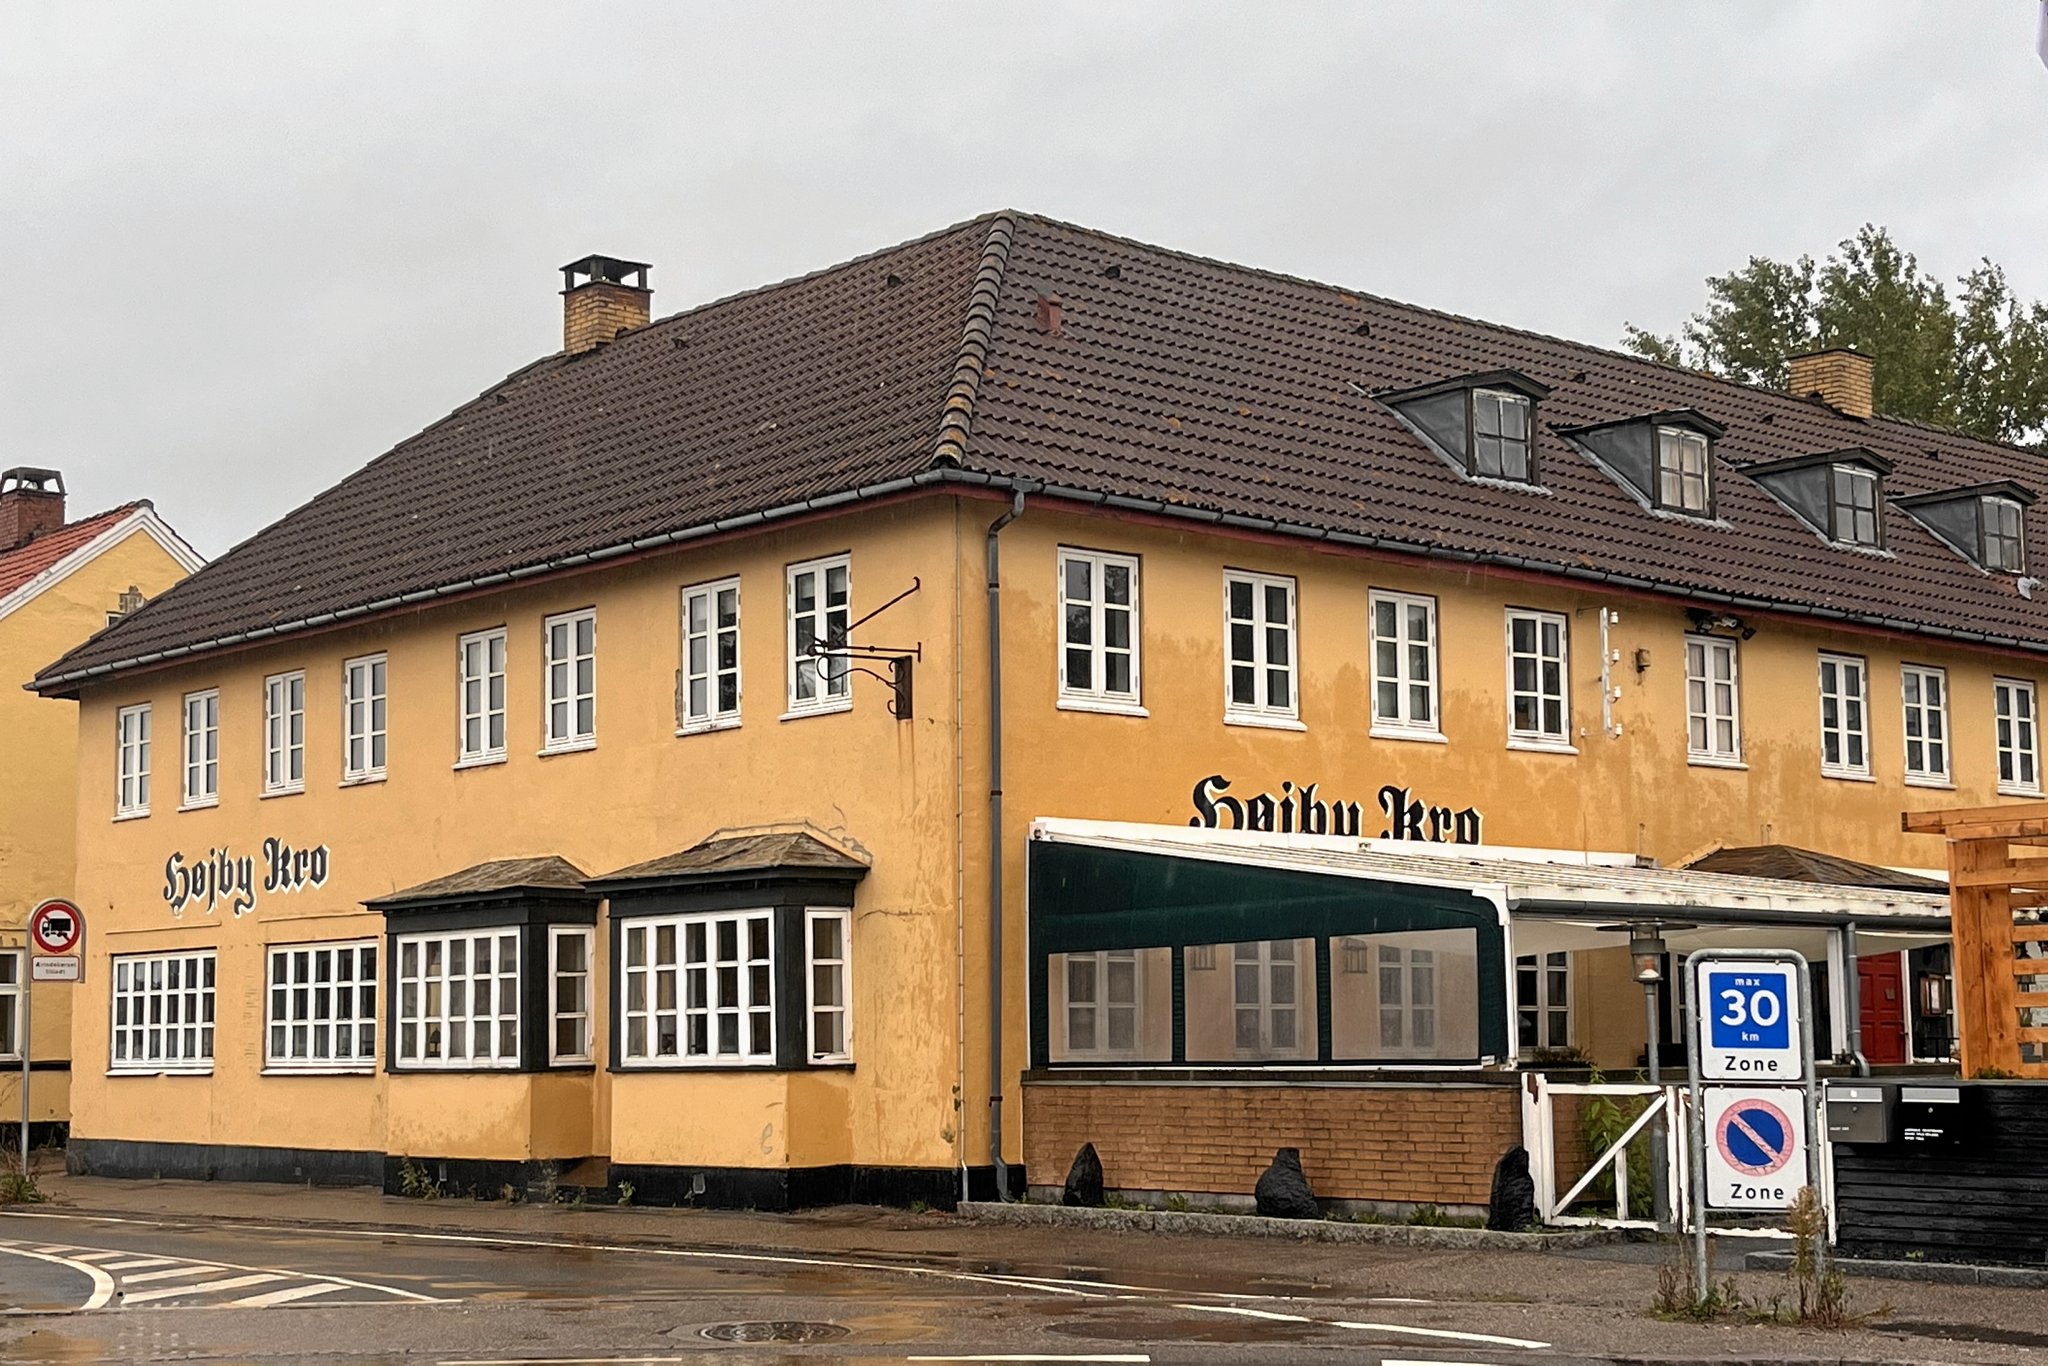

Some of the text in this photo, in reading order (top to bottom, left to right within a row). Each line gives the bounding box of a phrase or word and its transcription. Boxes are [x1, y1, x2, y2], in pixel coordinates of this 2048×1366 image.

[1377, 784, 1485, 845] Kro
[163, 837, 330, 918] Højby Kro
[1734, 977, 1760, 987] max
[1720, 989, 1780, 1027] 30
[1741, 1031, 1760, 1041] km
[1725, 1055, 1778, 1071] Zone
[1731, 1183, 1784, 1199] Zone
